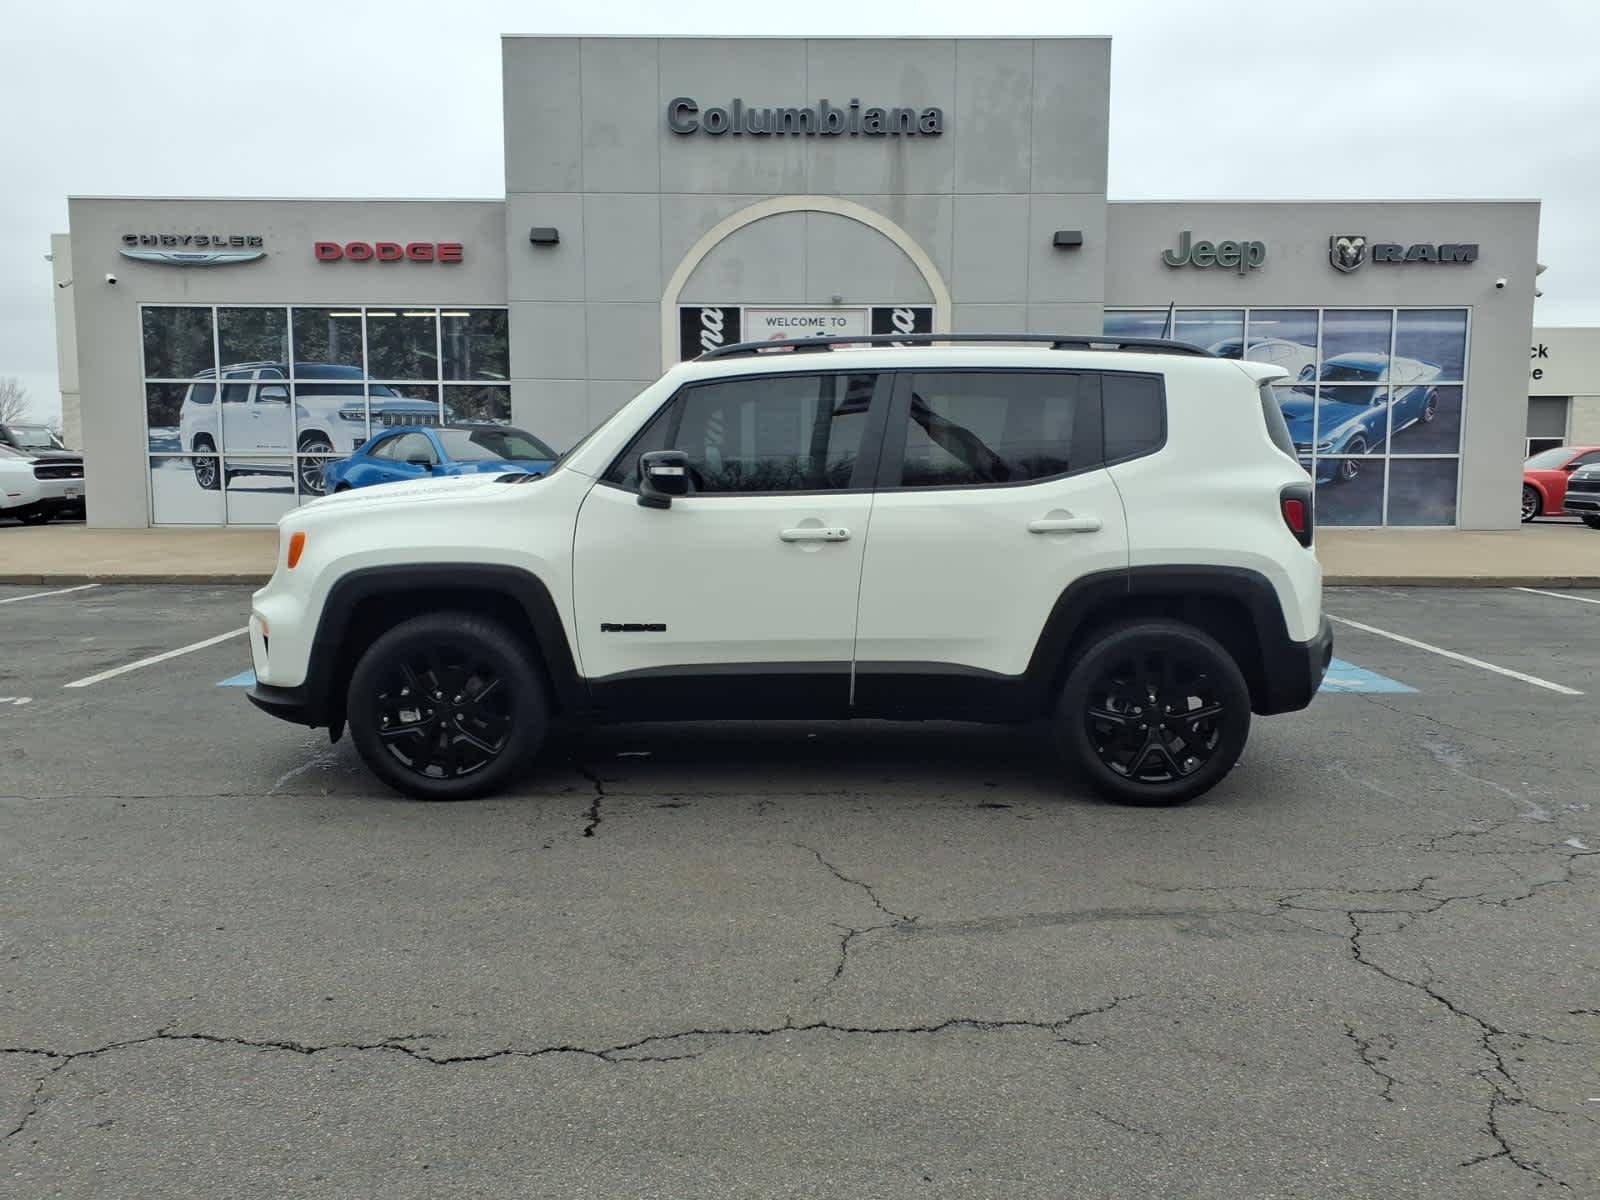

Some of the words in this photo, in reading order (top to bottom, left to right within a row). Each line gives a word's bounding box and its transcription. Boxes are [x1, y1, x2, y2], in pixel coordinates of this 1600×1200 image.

[667, 97, 943, 136] Columbiana
[122, 233, 264, 247] CHRYSLER
[314, 242, 464, 263] DODGE
[1163, 231, 1267, 275] Jeep
[1372, 243, 1480, 263] RAM
[766, 317, 825, 327] WELCOME
[831, 317, 847, 327] TO
